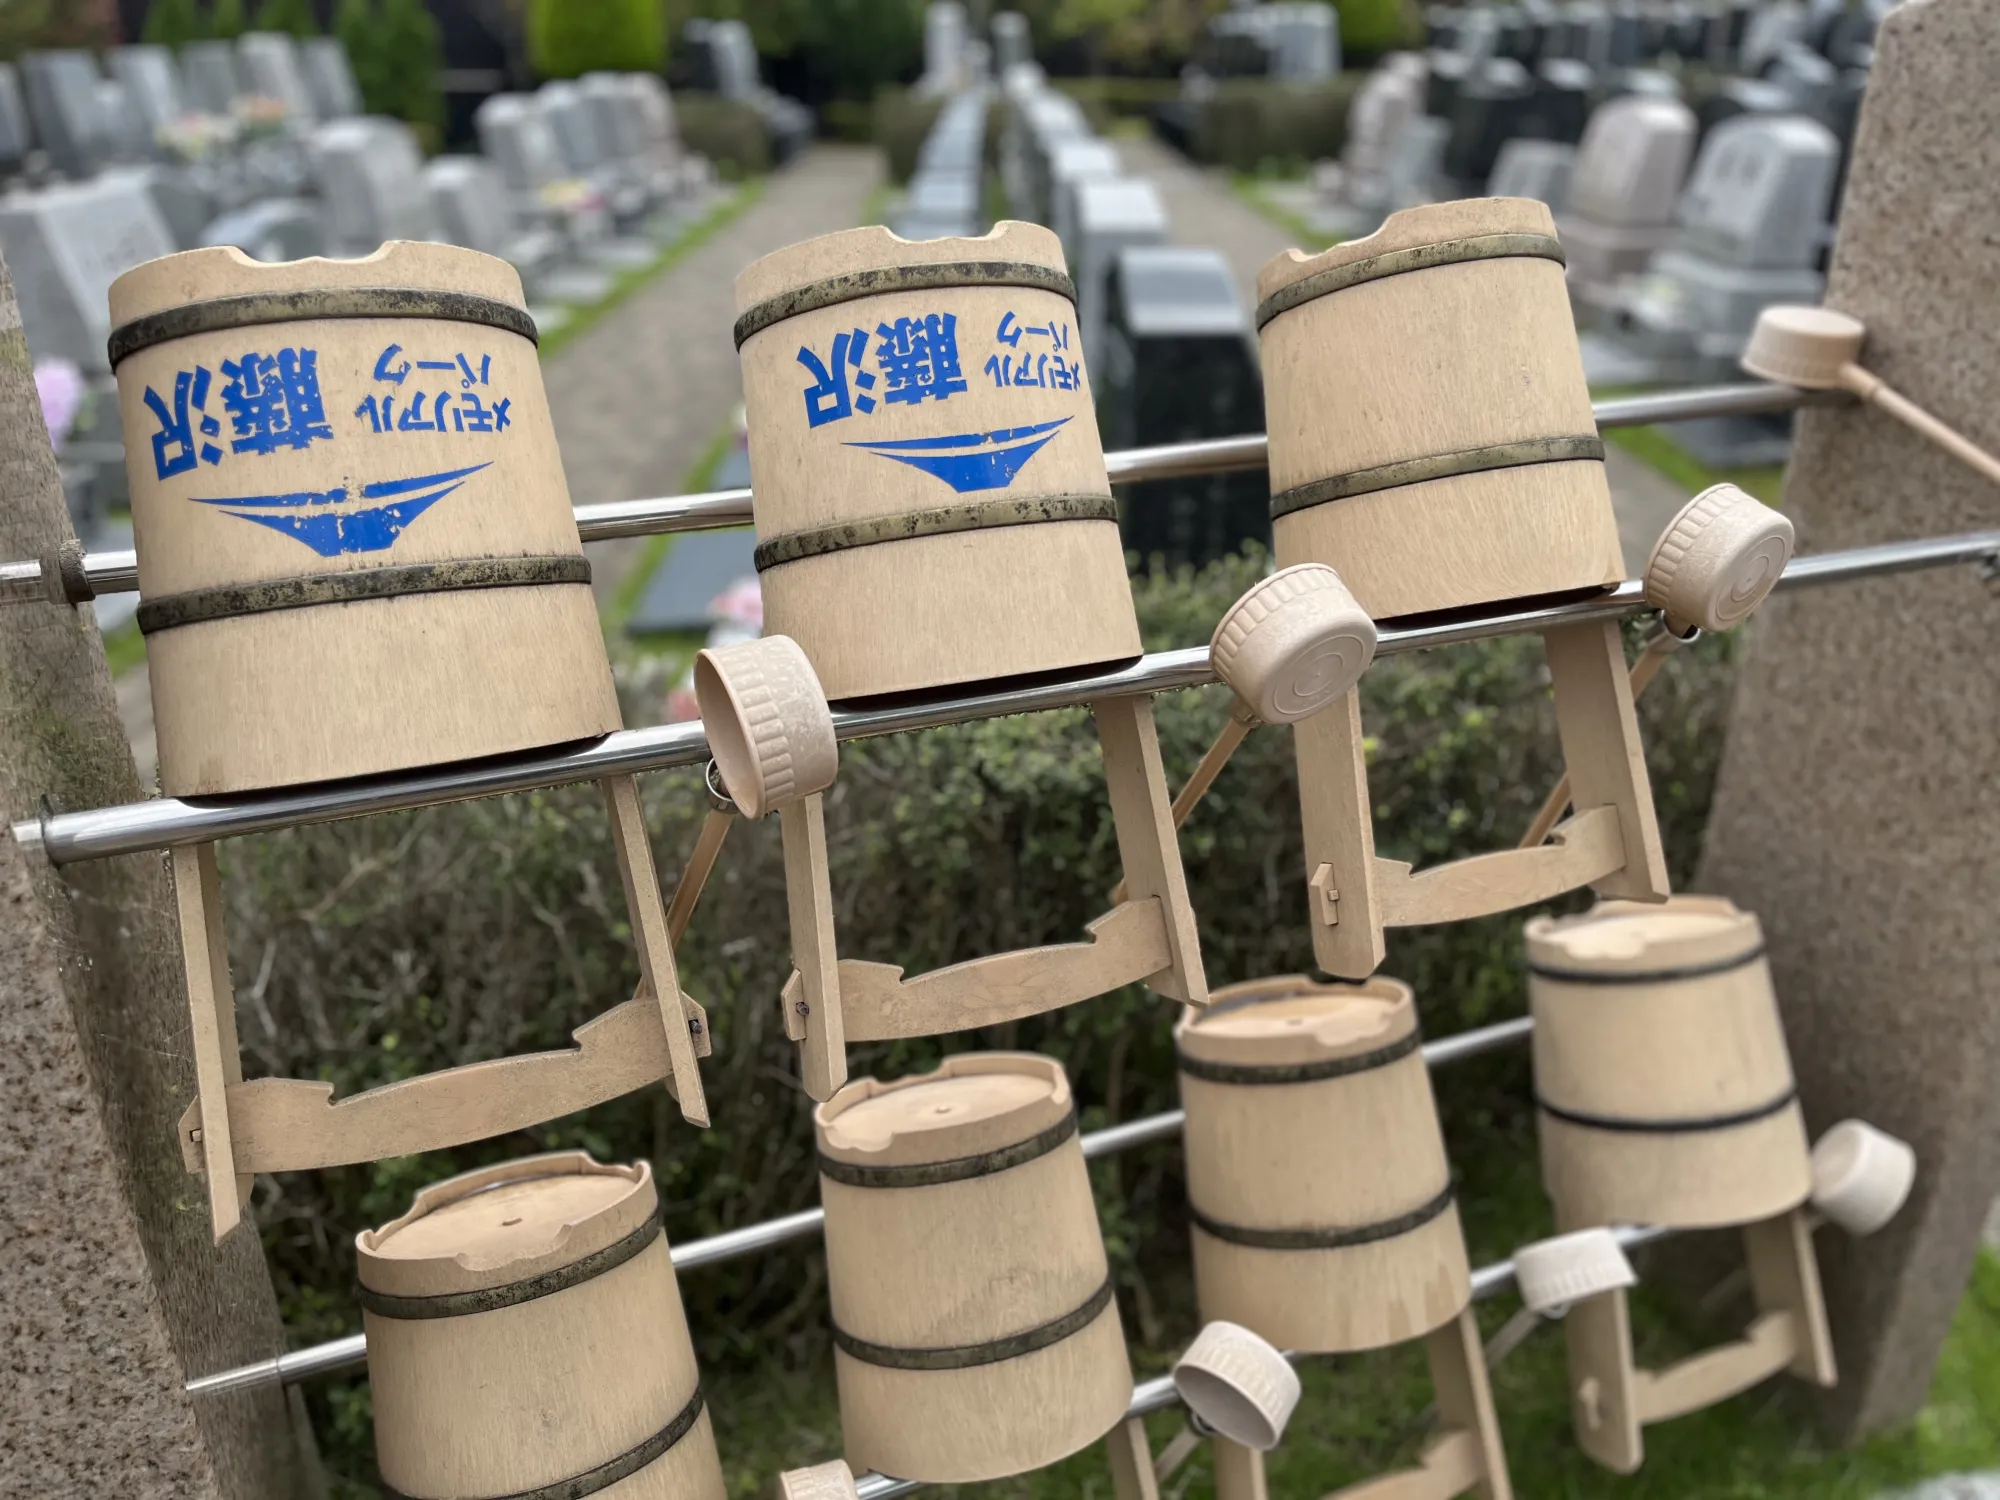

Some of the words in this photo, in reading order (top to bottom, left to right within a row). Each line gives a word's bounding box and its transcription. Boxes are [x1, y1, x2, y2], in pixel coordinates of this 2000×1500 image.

[997, 311, 1068, 352] パーク
[373, 344, 491, 390] パーク
[797, 312, 968, 429] 藤沢
[984, 351, 1081, 392] メモリアル
[144, 347, 335, 481] 藤沢
[354, 390, 512, 433] メモリアル
